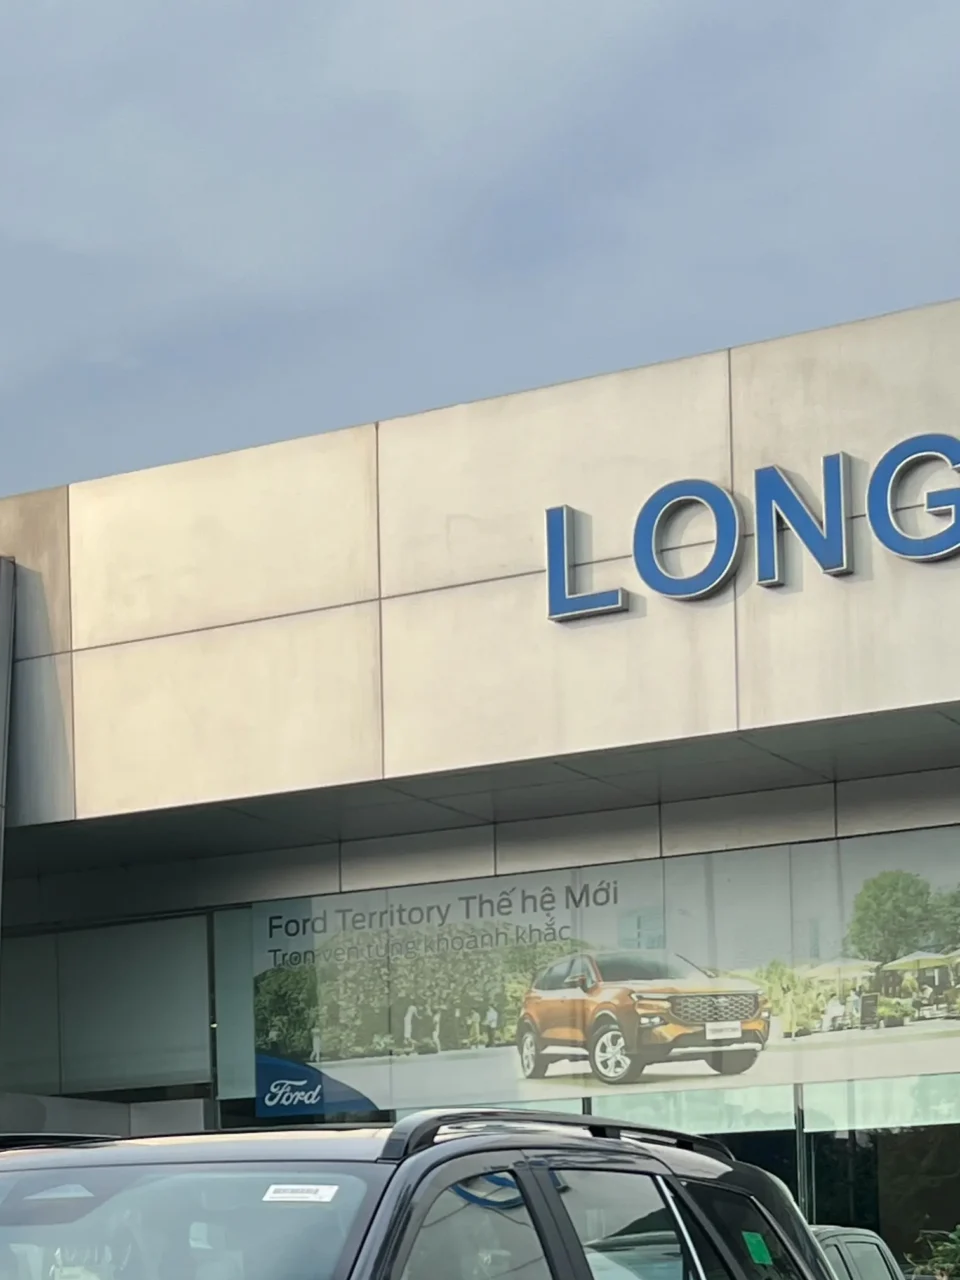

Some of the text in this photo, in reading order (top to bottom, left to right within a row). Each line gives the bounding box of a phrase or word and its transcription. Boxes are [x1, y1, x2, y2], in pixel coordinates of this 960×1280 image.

[545, 433, 960, 622] LONG
[268, 880, 618, 939] Ford Territory Thế hệ Mới
[515, 916, 571, 945] khắc
[264, 1079, 322, 1106] Ford
